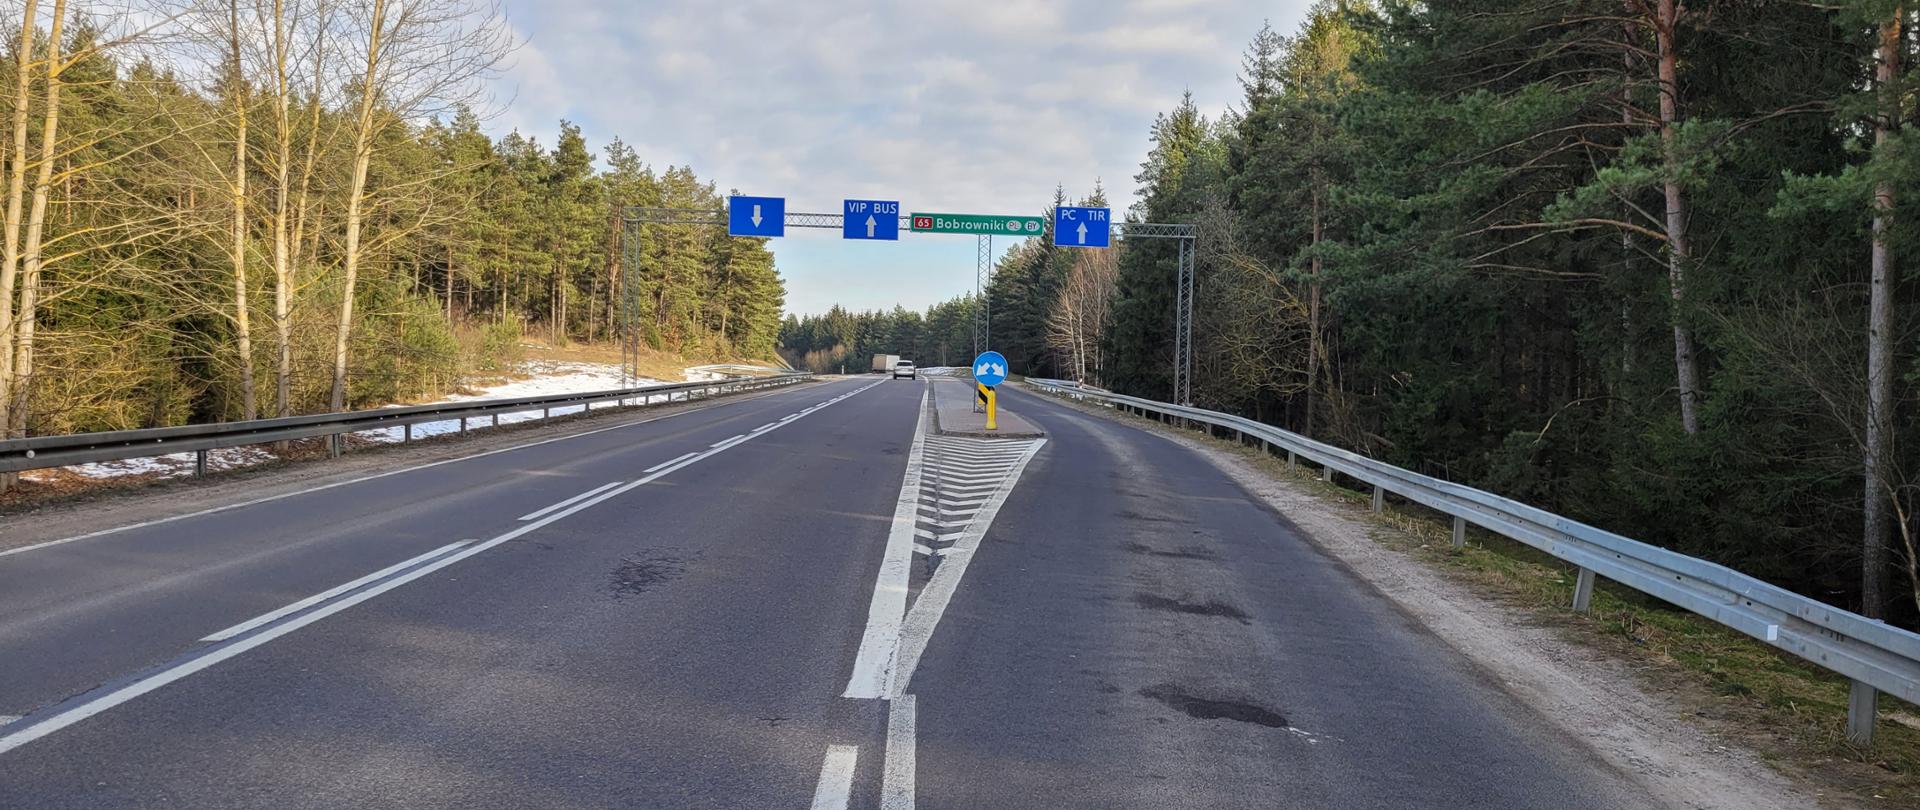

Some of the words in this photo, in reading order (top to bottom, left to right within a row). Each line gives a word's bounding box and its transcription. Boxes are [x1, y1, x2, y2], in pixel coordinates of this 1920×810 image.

[848, 202, 867, 213] VIP
[873, 203, 897, 214] BUS
[1061, 209, 1076, 220] PC
[1087, 210, 1106, 221] TIR
[917, 218, 929, 227] 65
[936, 218, 1004, 230] Bobrowniki
[1008, 221, 1018, 229] PL
[1027, 222, 1037, 230] BY
